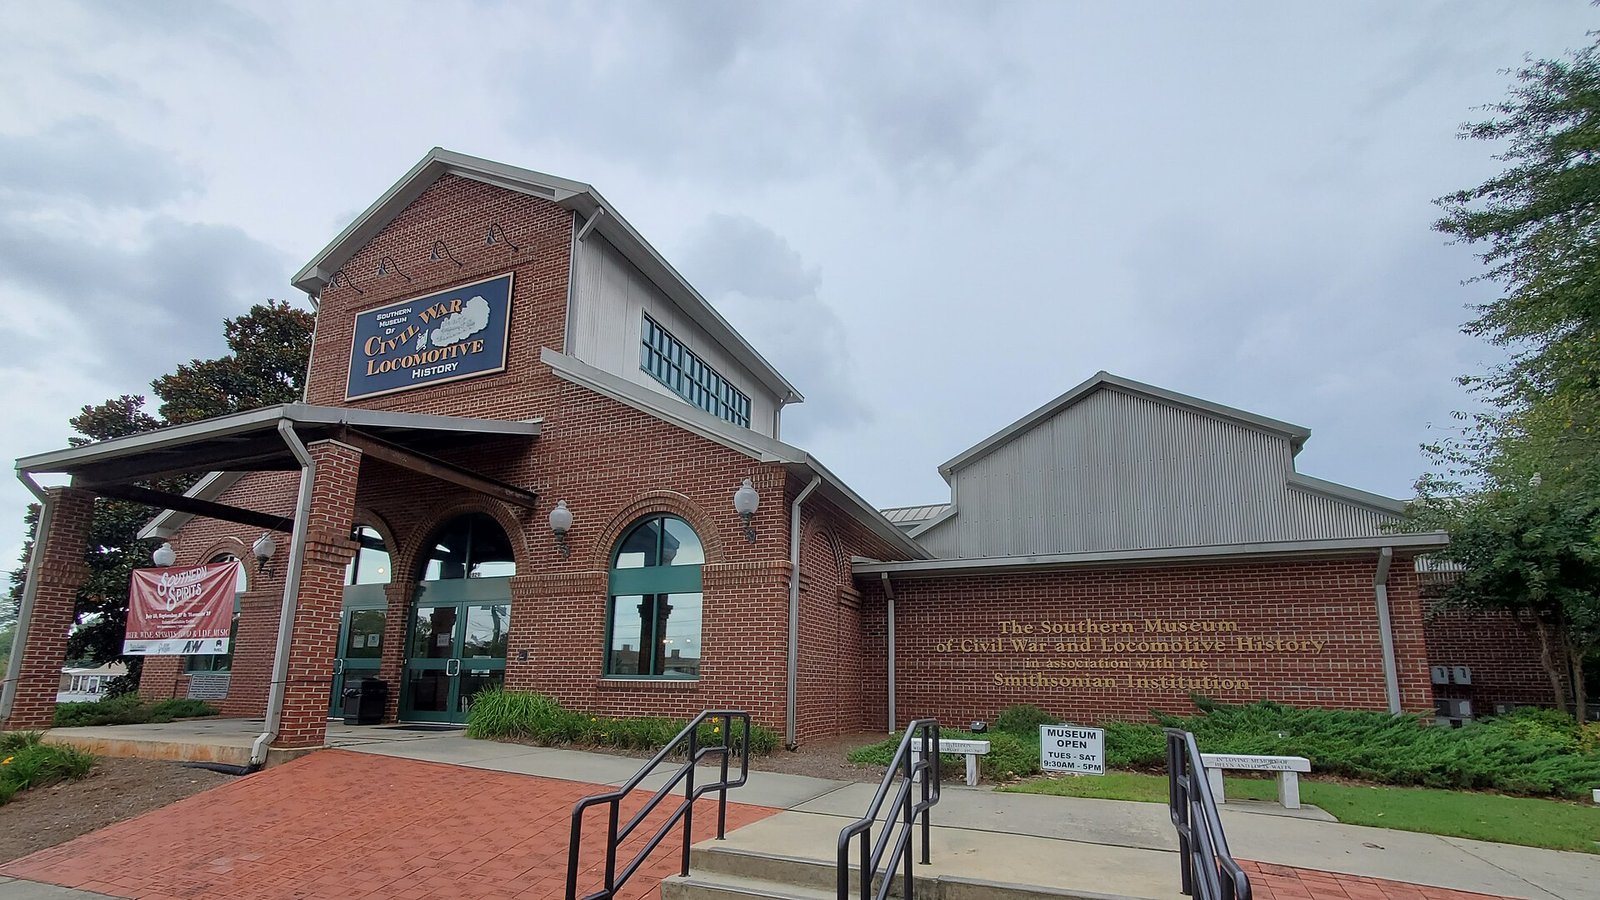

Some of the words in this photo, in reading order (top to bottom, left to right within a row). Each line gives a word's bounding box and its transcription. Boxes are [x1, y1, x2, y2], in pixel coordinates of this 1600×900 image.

[376, 307, 412, 321] SOUTHERN
[364, 323, 420, 357] CIVIL
[418, 299, 463, 324] WAR
[379, 316, 407, 328] MUSEUM
[385, 327, 396, 335] OF
[365, 339, 485, 377] LOCOMOTIVE
[411, 361, 459, 379] HISTORY
[157, 565, 208, 597] SOUTHERN
[166, 583, 202, 611] SPIRITS
[998, 620, 1034, 634] The
[1041, 618, 1134, 634] Southern
[1144, 619, 1239, 633] Museum
[936, 638, 954, 653] of
[960, 638, 1003, 653] Civil
[1011, 638, 1048, 653] War
[1055, 638, 1092, 653] and
[1100, 637, 1226, 653] Locomotive
[1236, 637, 1328, 655] History
[1025, 657, 1040, 669] in
[1046, 657, 1130, 669] association
[1136, 656, 1174, 669] with
[1180, 656, 1209, 669] the
[993, 672, 1117, 688] Smithsonian
[1127, 673, 1251, 690] Institution
[1047, 728, 1097, 740] MUSEUM
[1056, 739, 1087, 749] OPEN
[1048, 751, 1071, 760] TUES
[1079, 753, 1096, 761] SAT
[1043, 759, 1075, 769] 9:30AM
[1082, 763, 1102, 771] 5PM
